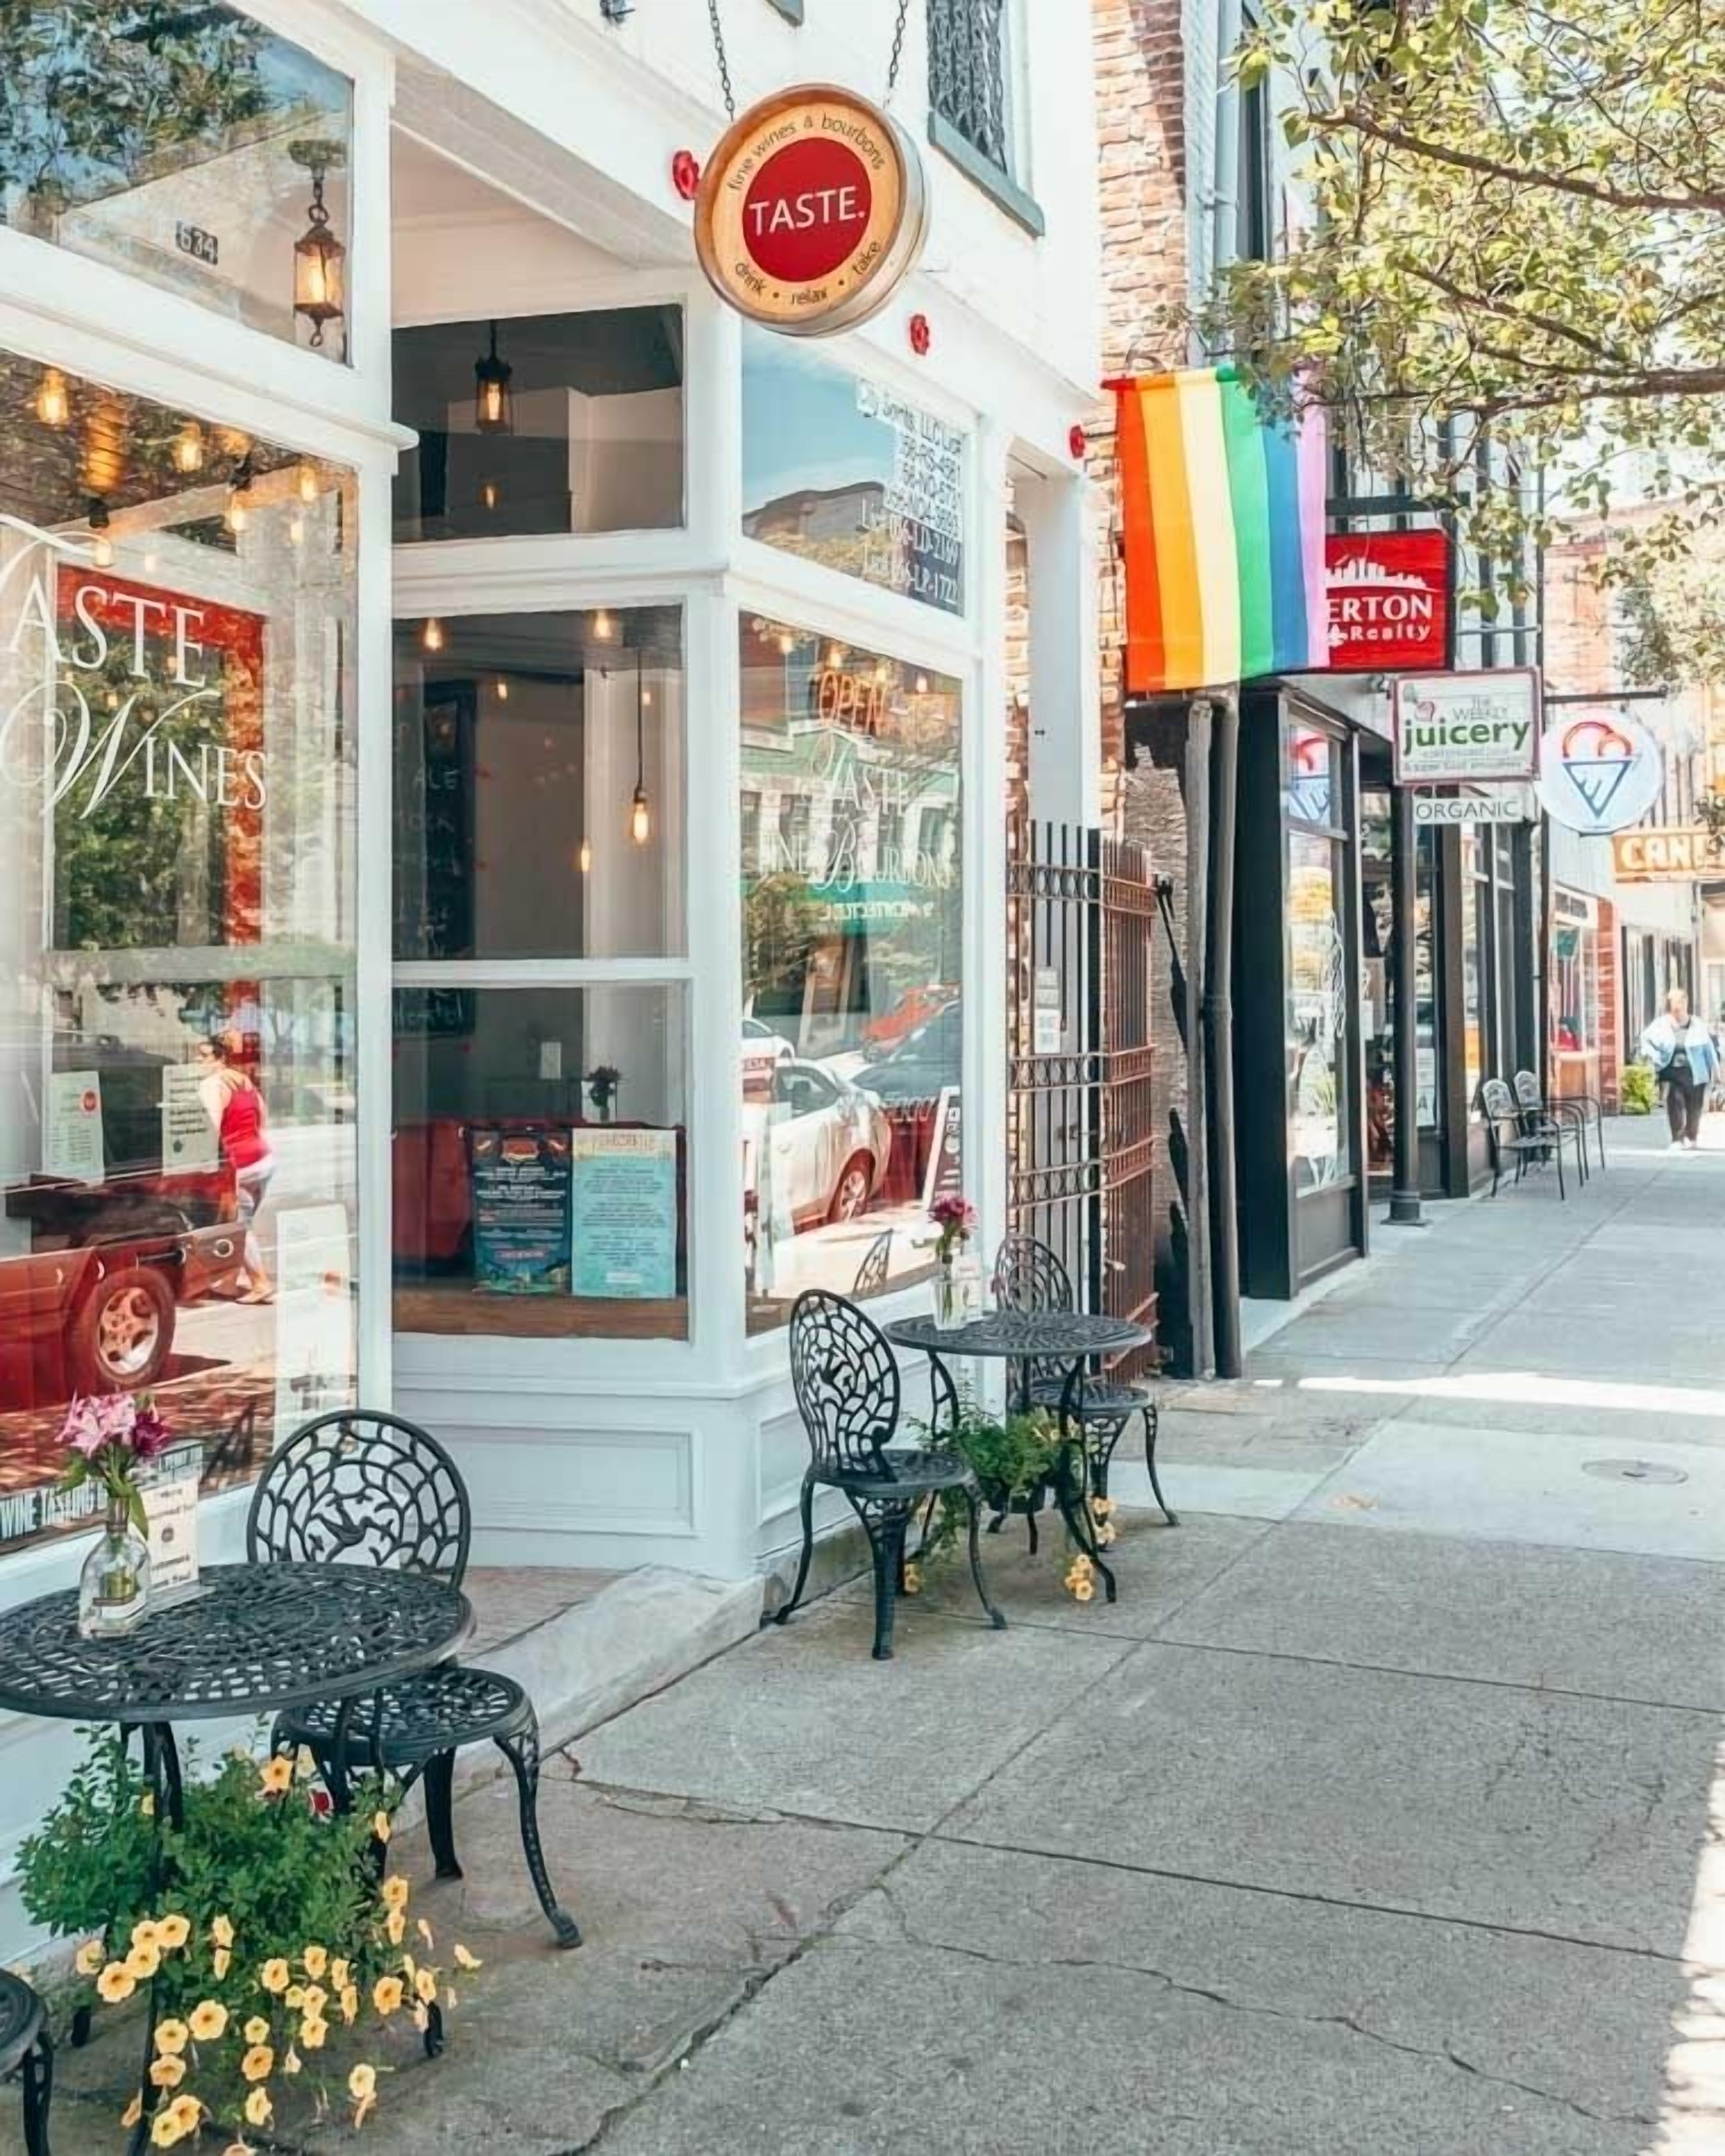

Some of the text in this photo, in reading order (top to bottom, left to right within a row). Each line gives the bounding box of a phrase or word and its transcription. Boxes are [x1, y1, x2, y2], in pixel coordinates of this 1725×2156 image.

[727, 158, 755, 191] fine
[754, 123, 797, 159] wines
[822, 113, 886, 171] bourbons
[748, 186, 866, 237] TASTE.
[734, 241, 882, 305] drink relax take
[1350, 622, 1432, 643] Realty
[819, 669, 887, 735] OPEN
[1, 681, 268, 820] WINES
[1403, 717, 1531, 756] juicery
[1416, 801, 1518, 819] ORGANIC
[815, 818, 952, 892] BURONS
